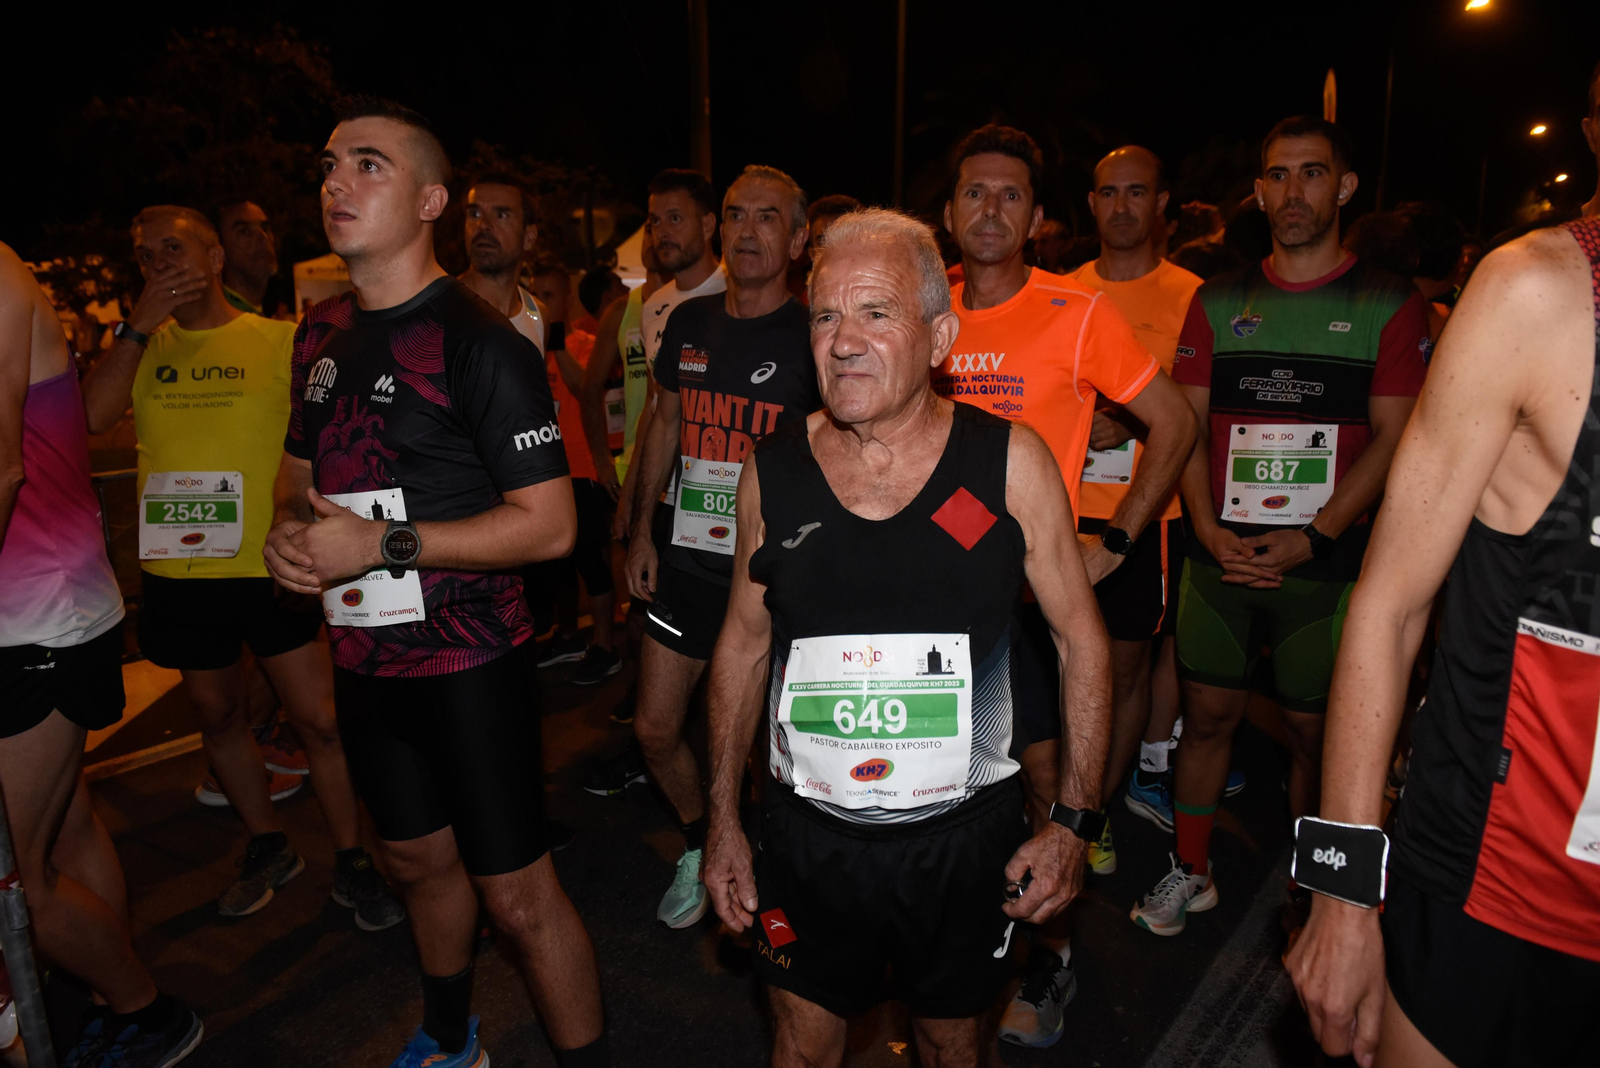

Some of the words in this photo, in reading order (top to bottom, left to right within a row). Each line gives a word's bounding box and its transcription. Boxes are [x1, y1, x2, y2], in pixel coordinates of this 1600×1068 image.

[679, 362, 708, 373] MADRID
[950, 353, 1006, 373] XXXV
[933, 375, 968, 385] ARRERA
[971, 374, 1025, 384] NOCTURNA
[1240, 377, 1323, 395] FERROVIARIO
[371, 394, 393, 404] mobel
[934, 384, 1024, 397] GUADALQUIVIR
[1270, 393, 1301, 402] SEVILLA
[679, 386, 750, 430] WANT
[751, 401, 785, 435] IT
[680, 420, 762, 464] MOR
[1255, 460, 1300, 481] 687
[163, 503, 218, 521] 2542
[703, 492, 737, 515] 802
[379, 607, 418, 618] Cruzcampo
[1517, 622, 1585, 648] TAÑISMO
[833, 699, 907, 735] 649
[810, 736, 839, 749] PASTOR
[840, 741, 894, 751] CABALLERO
[895, 740, 942, 750] EXPOSITO
[912, 782, 957, 797] Cruzcampo
[1312, 845, 1348, 871] edp
[757, 939, 791, 970] TALAI
